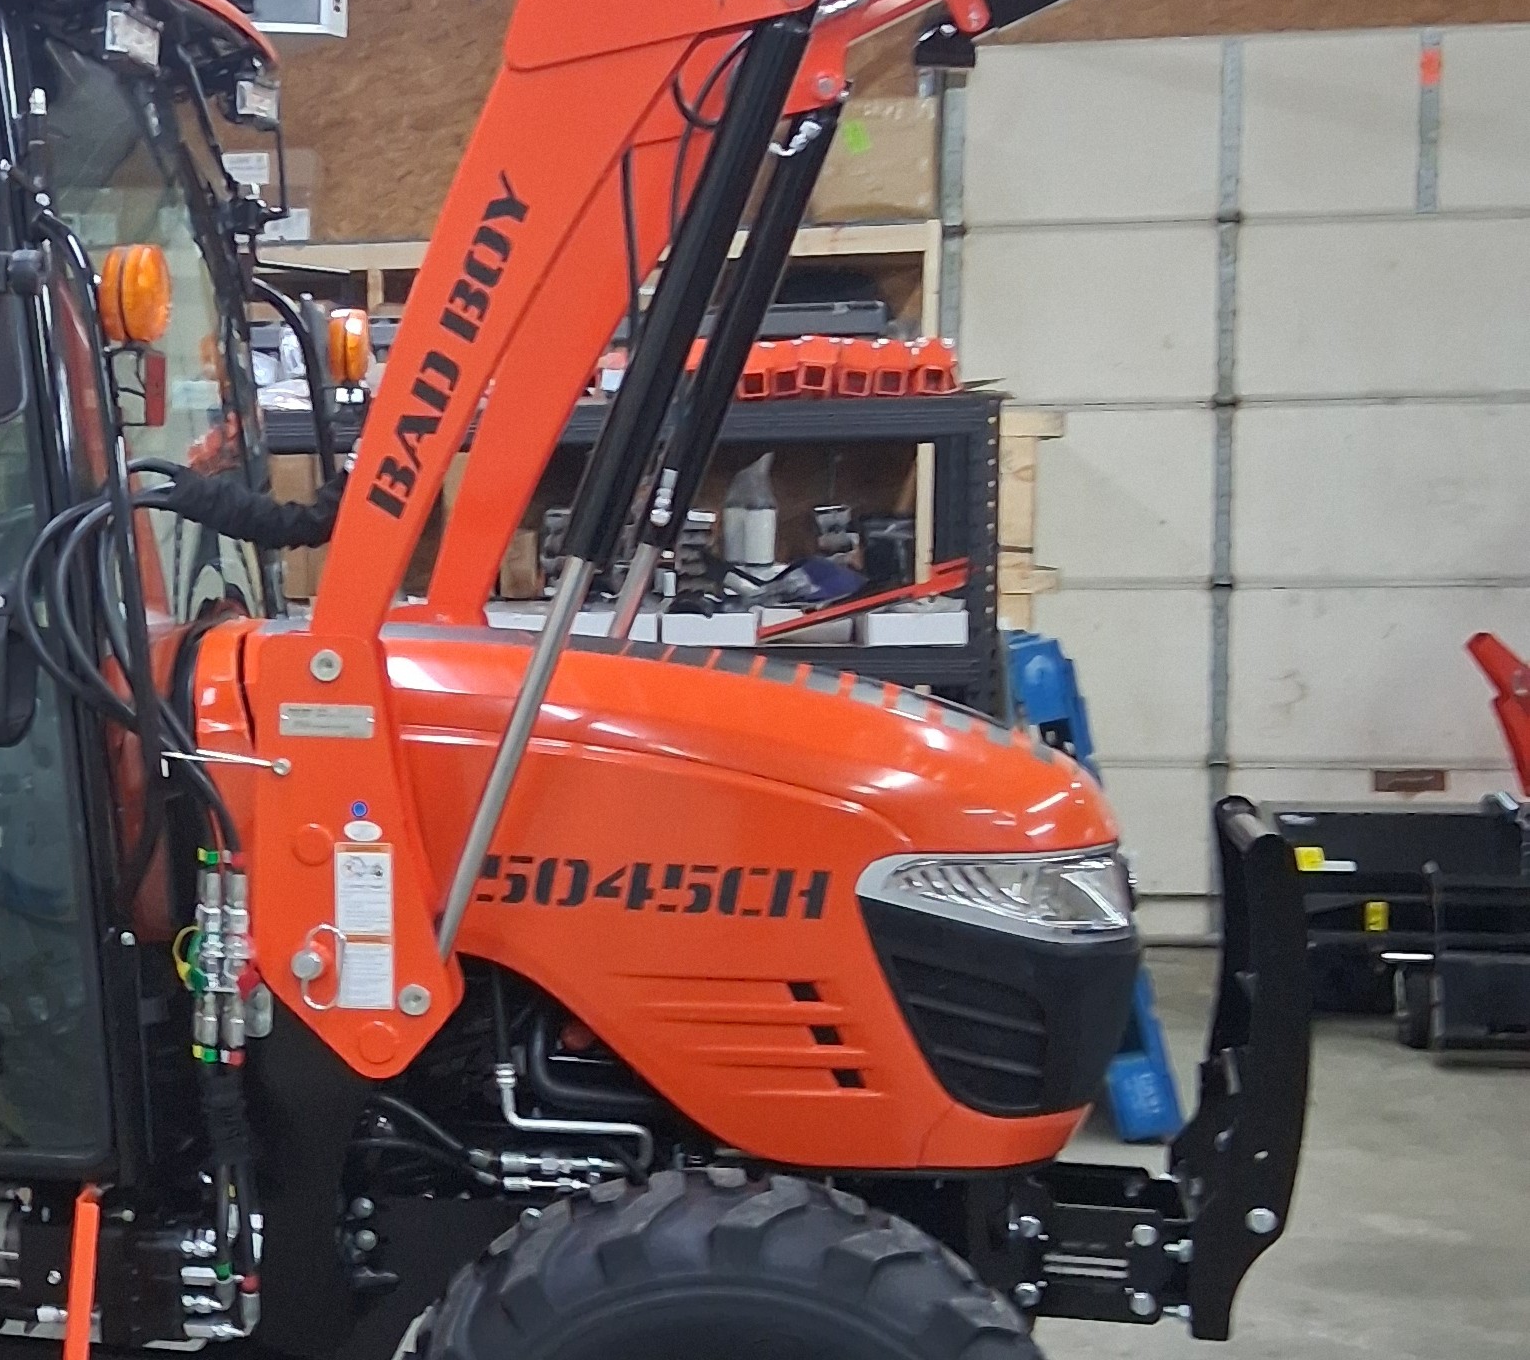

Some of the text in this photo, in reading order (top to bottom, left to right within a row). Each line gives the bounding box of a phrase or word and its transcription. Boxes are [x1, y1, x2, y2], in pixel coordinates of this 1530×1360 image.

[367, 170, 529, 519] BAD BOY
[476, 854, 831, 920] 5045CH
